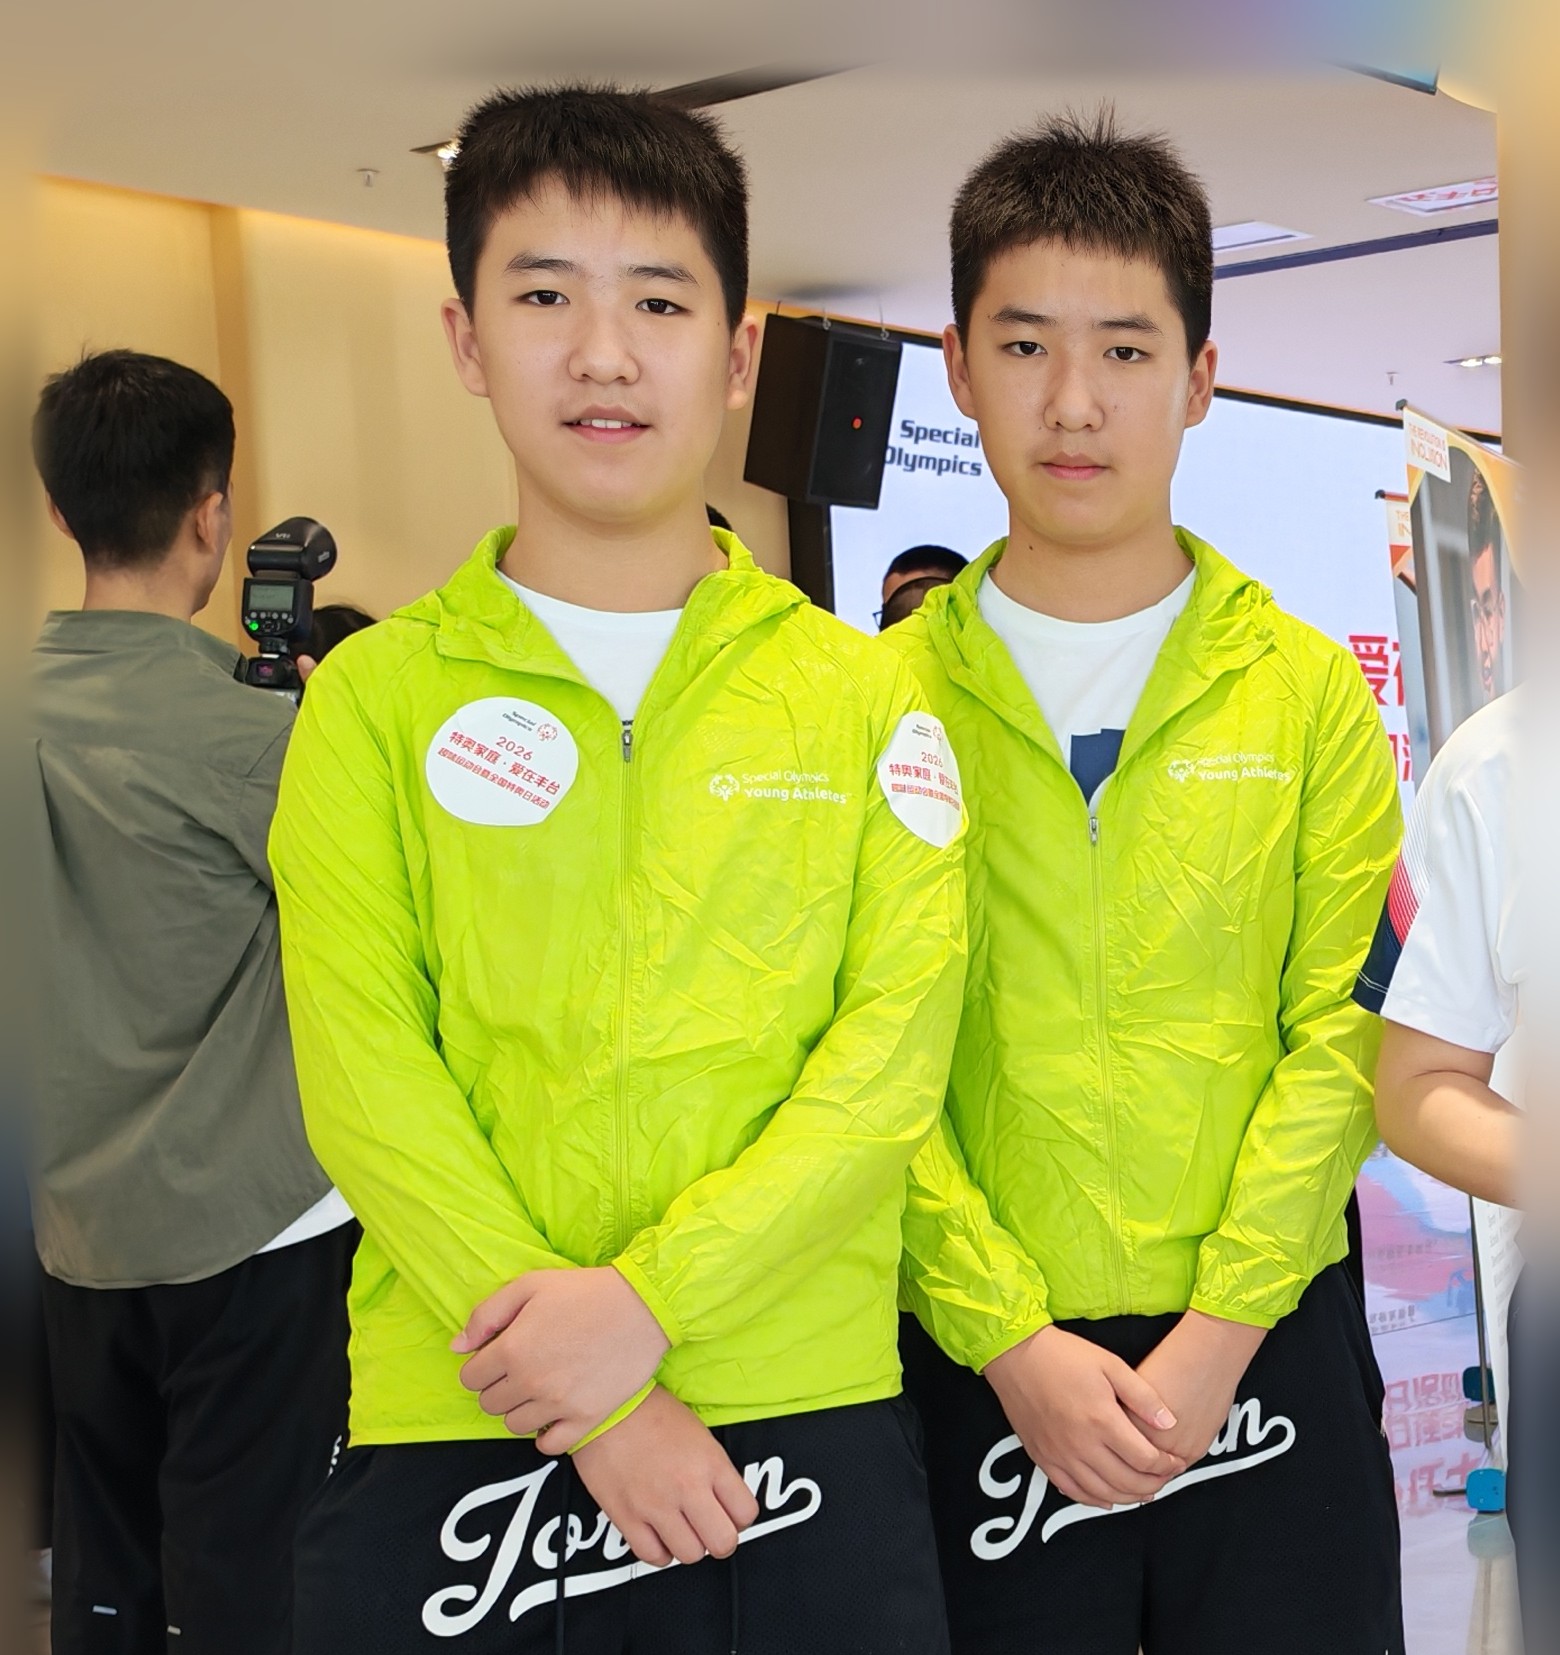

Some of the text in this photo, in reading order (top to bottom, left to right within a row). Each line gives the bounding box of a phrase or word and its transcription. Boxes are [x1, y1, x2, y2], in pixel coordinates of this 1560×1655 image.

[899, 419, 980, 448] Special
[885, 445, 982, 476] Olympics
[496, 736, 534, 761] 2026
[742, 770, 829, 784] Special Olympics
[1198, 769, 1239, 781] Young
[744, 786, 847, 805] Young Athletes
[421, 1456, 822, 1638] Jorn
